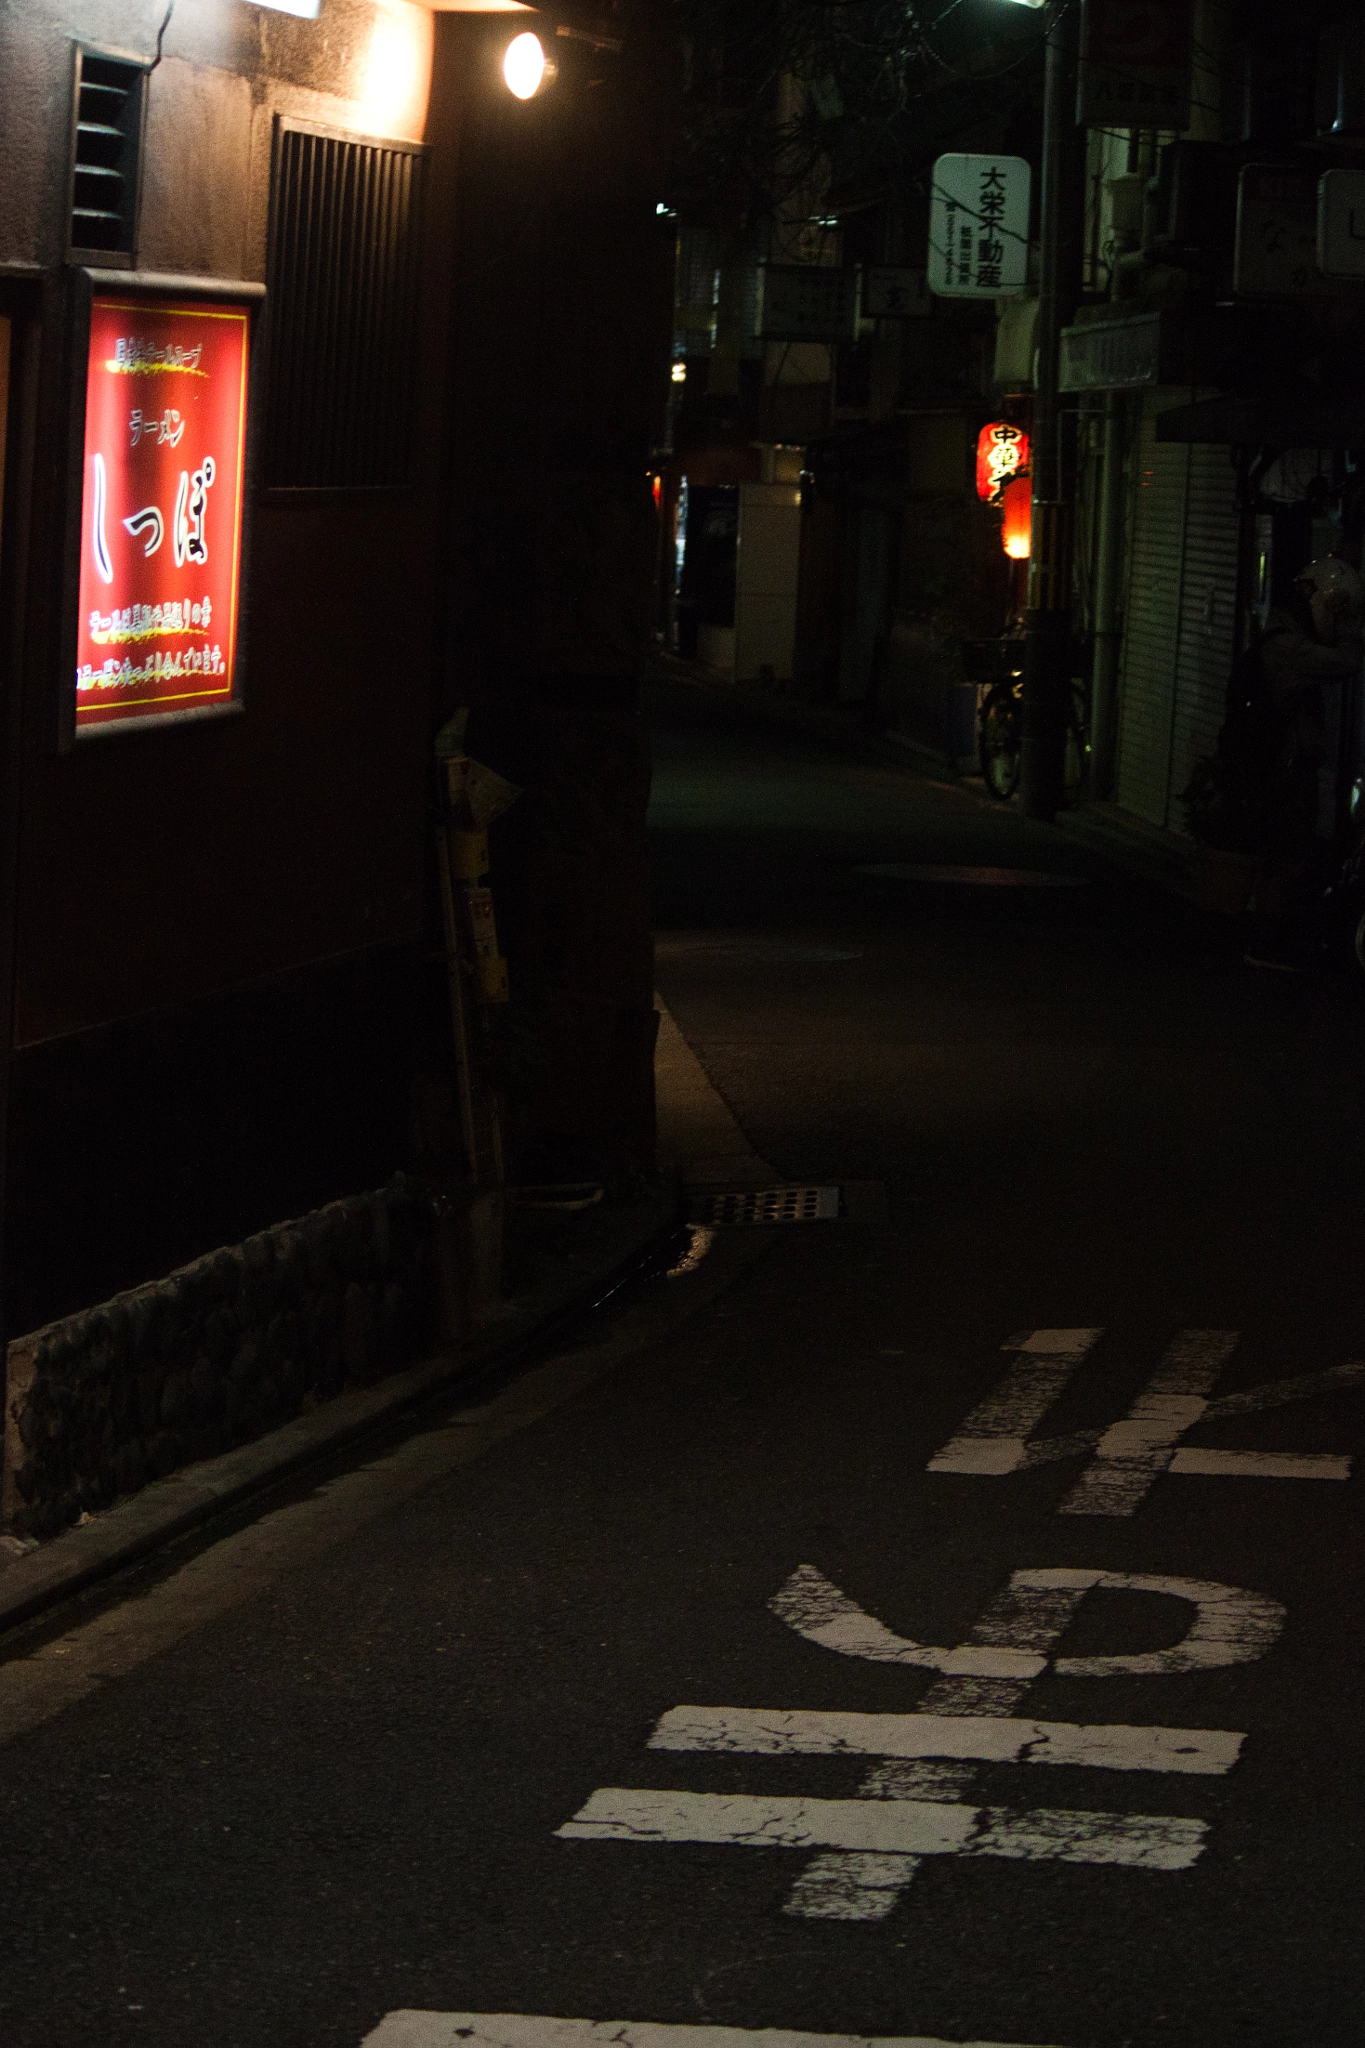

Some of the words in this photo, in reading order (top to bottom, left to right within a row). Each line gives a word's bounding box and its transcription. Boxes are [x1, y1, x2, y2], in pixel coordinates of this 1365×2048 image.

[976, 166, 1007, 288] 大栄不動産
[128, 408, 185, 449] ラーメン
[92, 451, 216, 584] しっぽ
